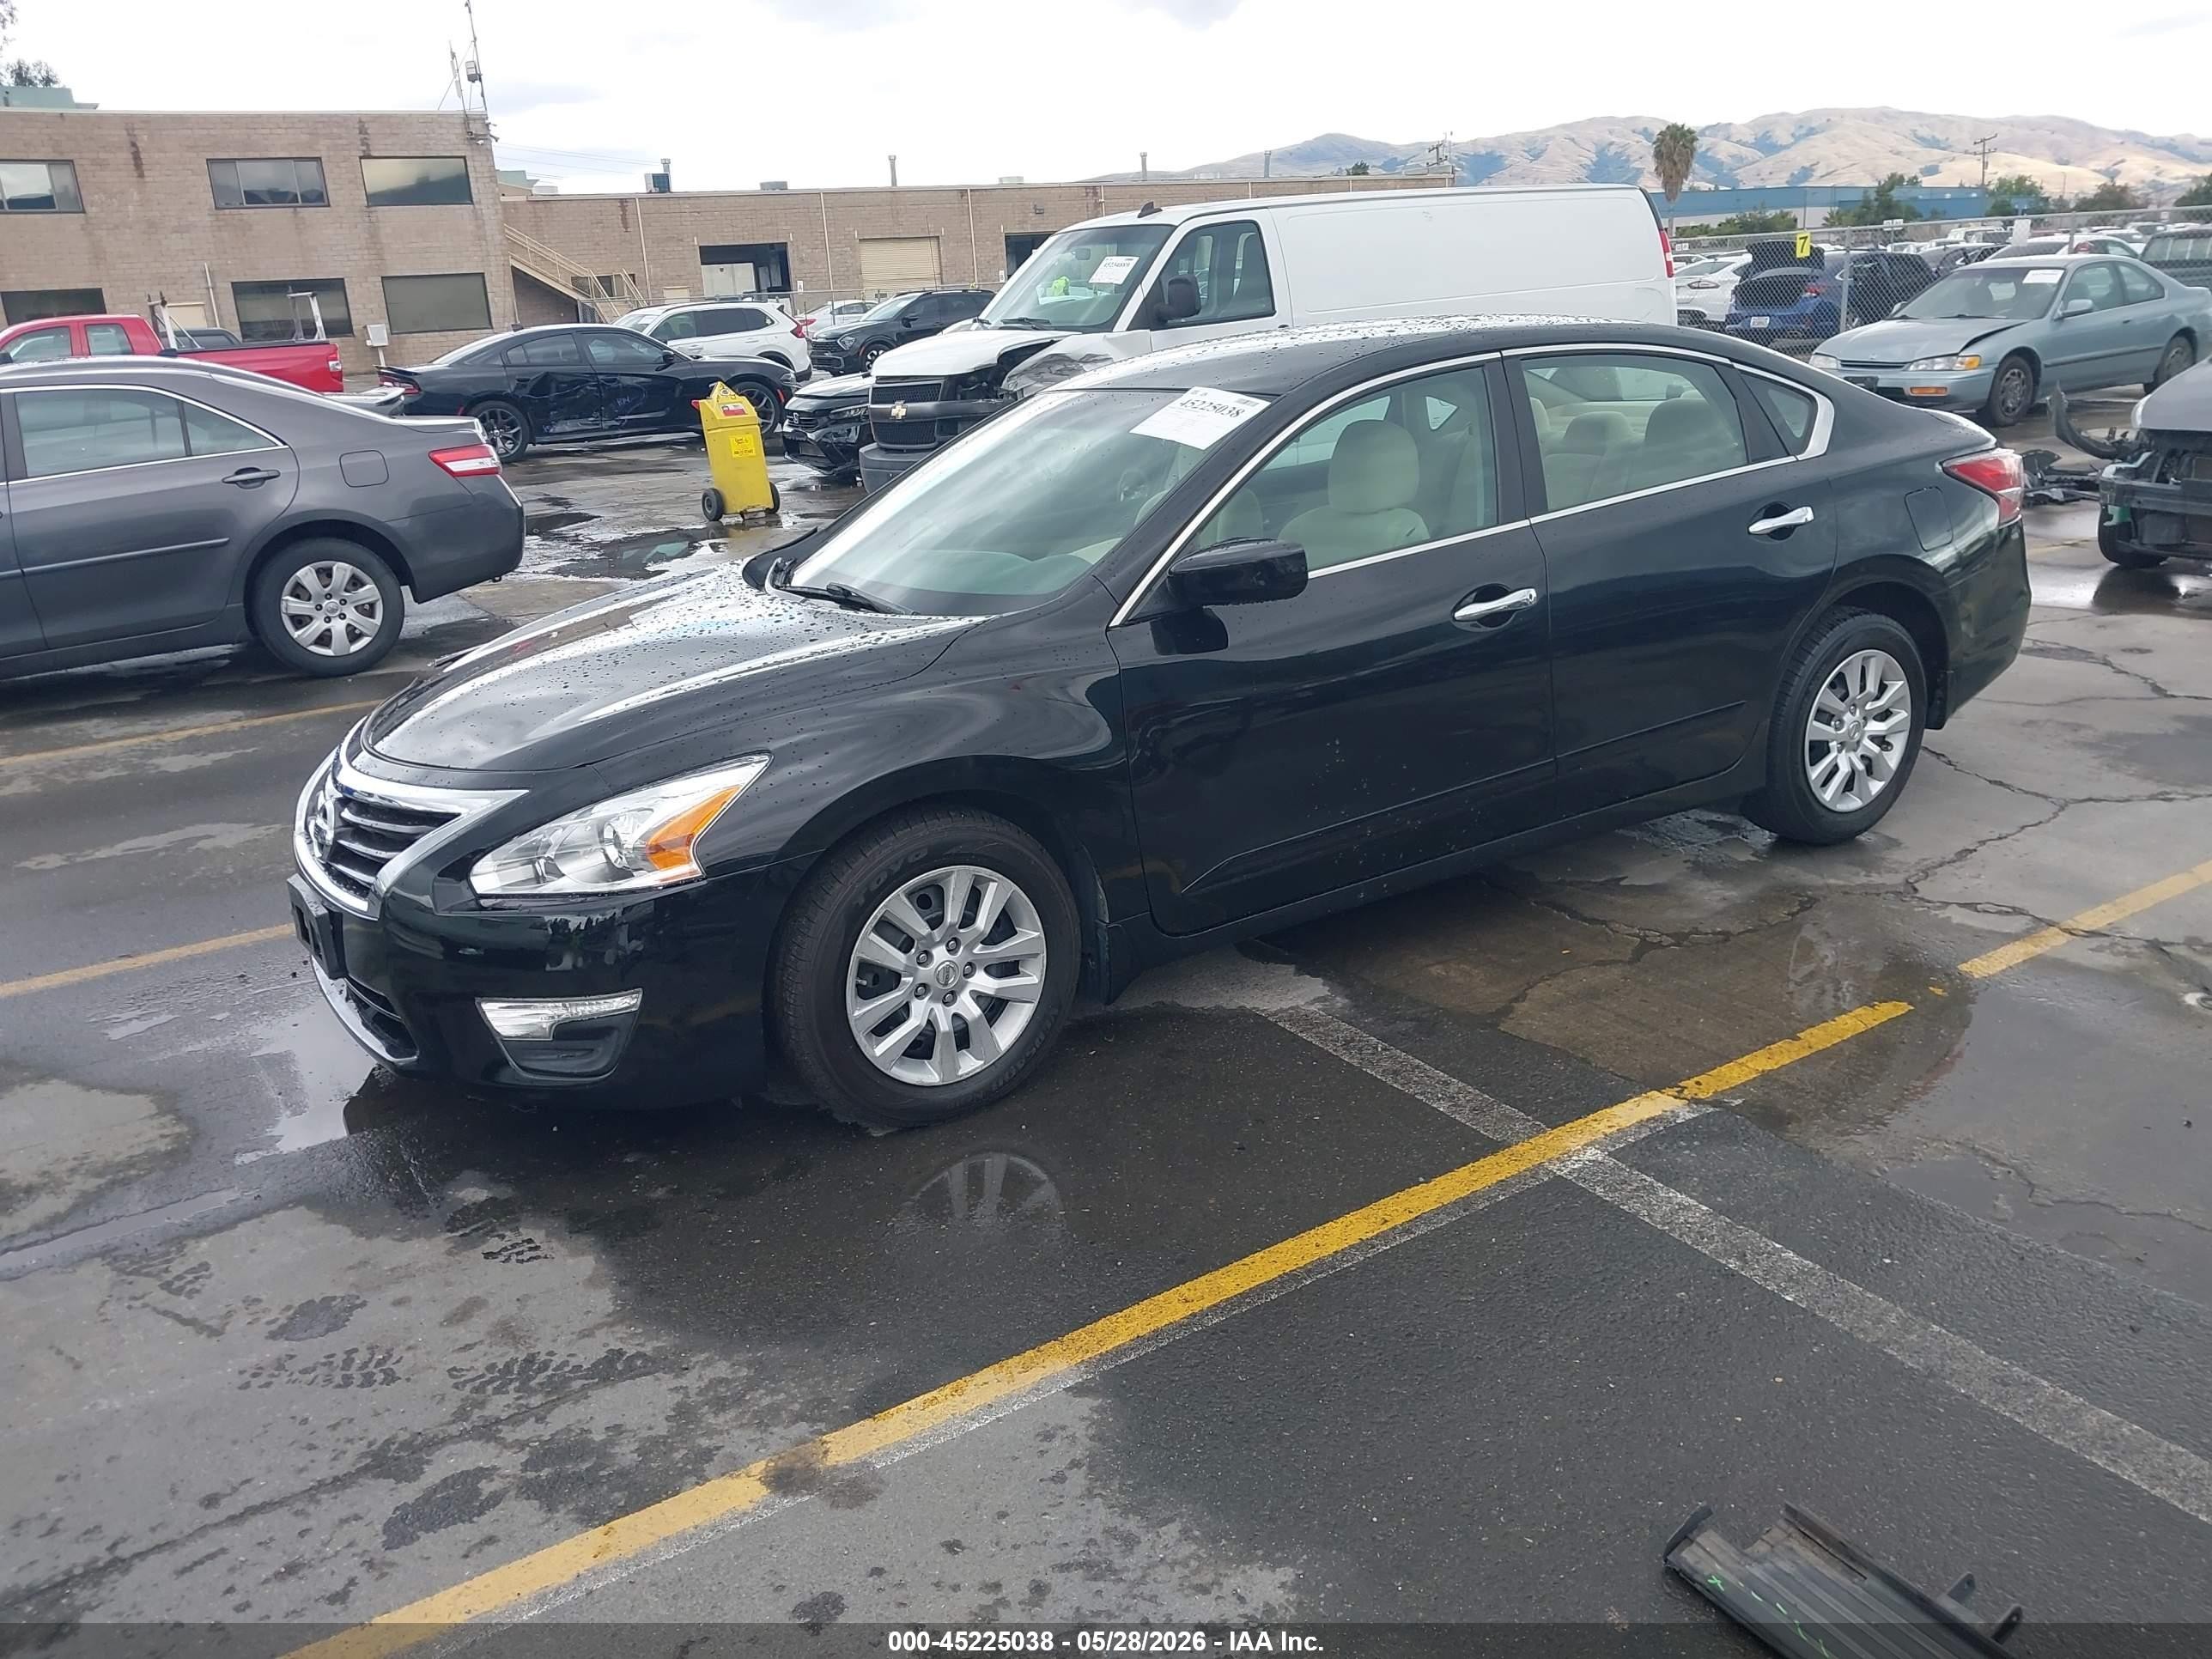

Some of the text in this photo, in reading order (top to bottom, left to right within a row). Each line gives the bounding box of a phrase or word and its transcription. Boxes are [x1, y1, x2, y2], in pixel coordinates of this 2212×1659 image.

[1799, 235, 1808, 253] 7
[1180, 398, 1245, 417] 45225038
[851, 847, 929, 908] TOYO
